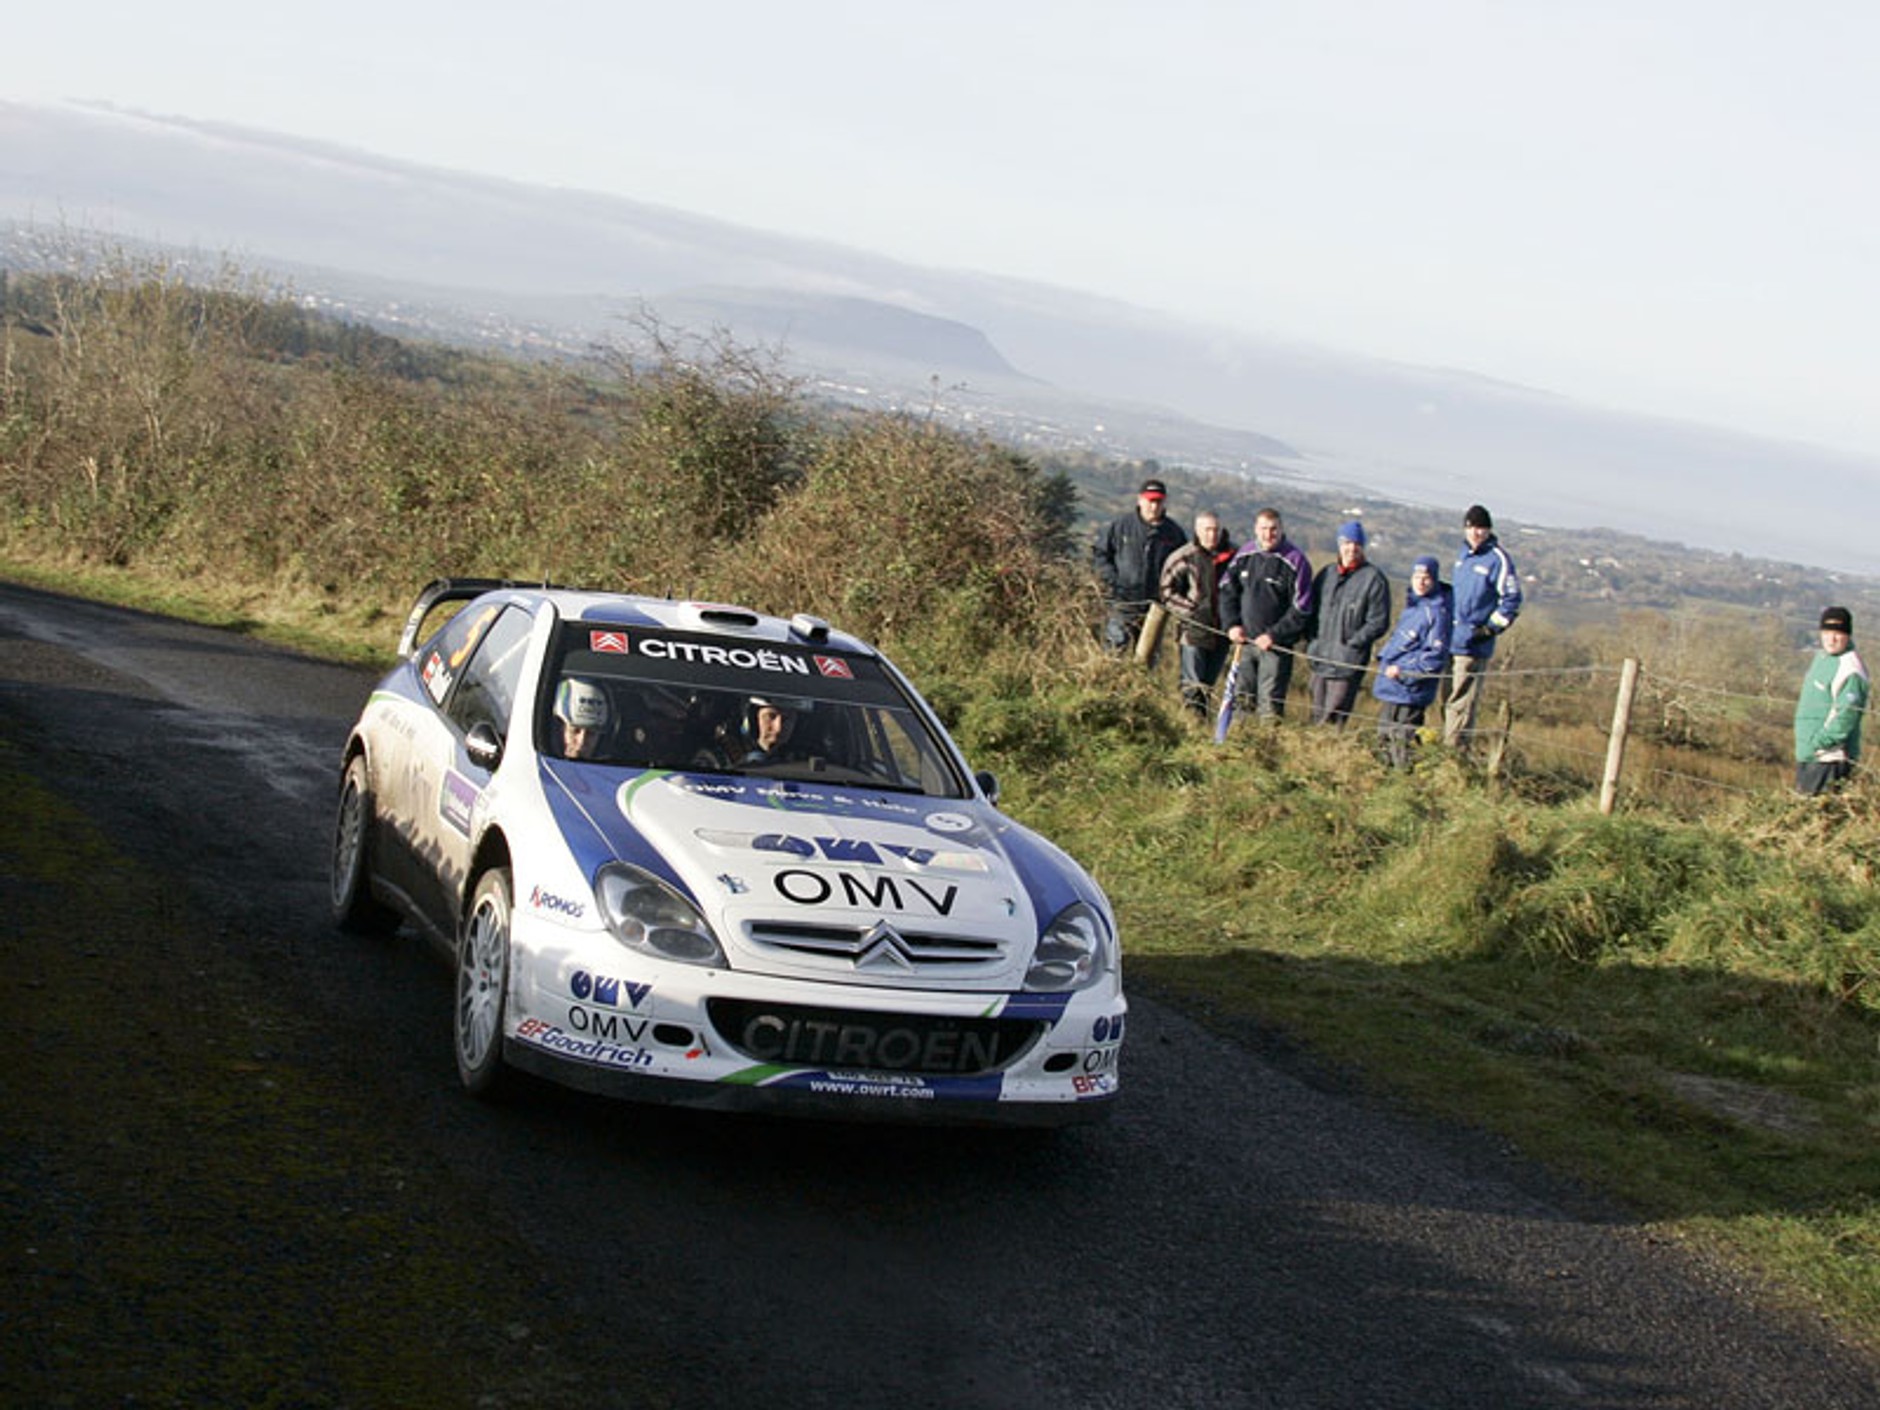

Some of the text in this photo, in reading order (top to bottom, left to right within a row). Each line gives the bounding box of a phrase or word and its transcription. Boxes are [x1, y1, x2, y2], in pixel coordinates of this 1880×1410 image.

[639, 638, 810, 675] CITROËN
[774, 869, 958, 916] OMV
[516, 1018, 653, 1066] BFGoodrich
[568, 1005, 649, 1042] OMV
[742, 1014, 1000, 1071] CITROËN
[810, 1081, 934, 1099] www.owrt.com
